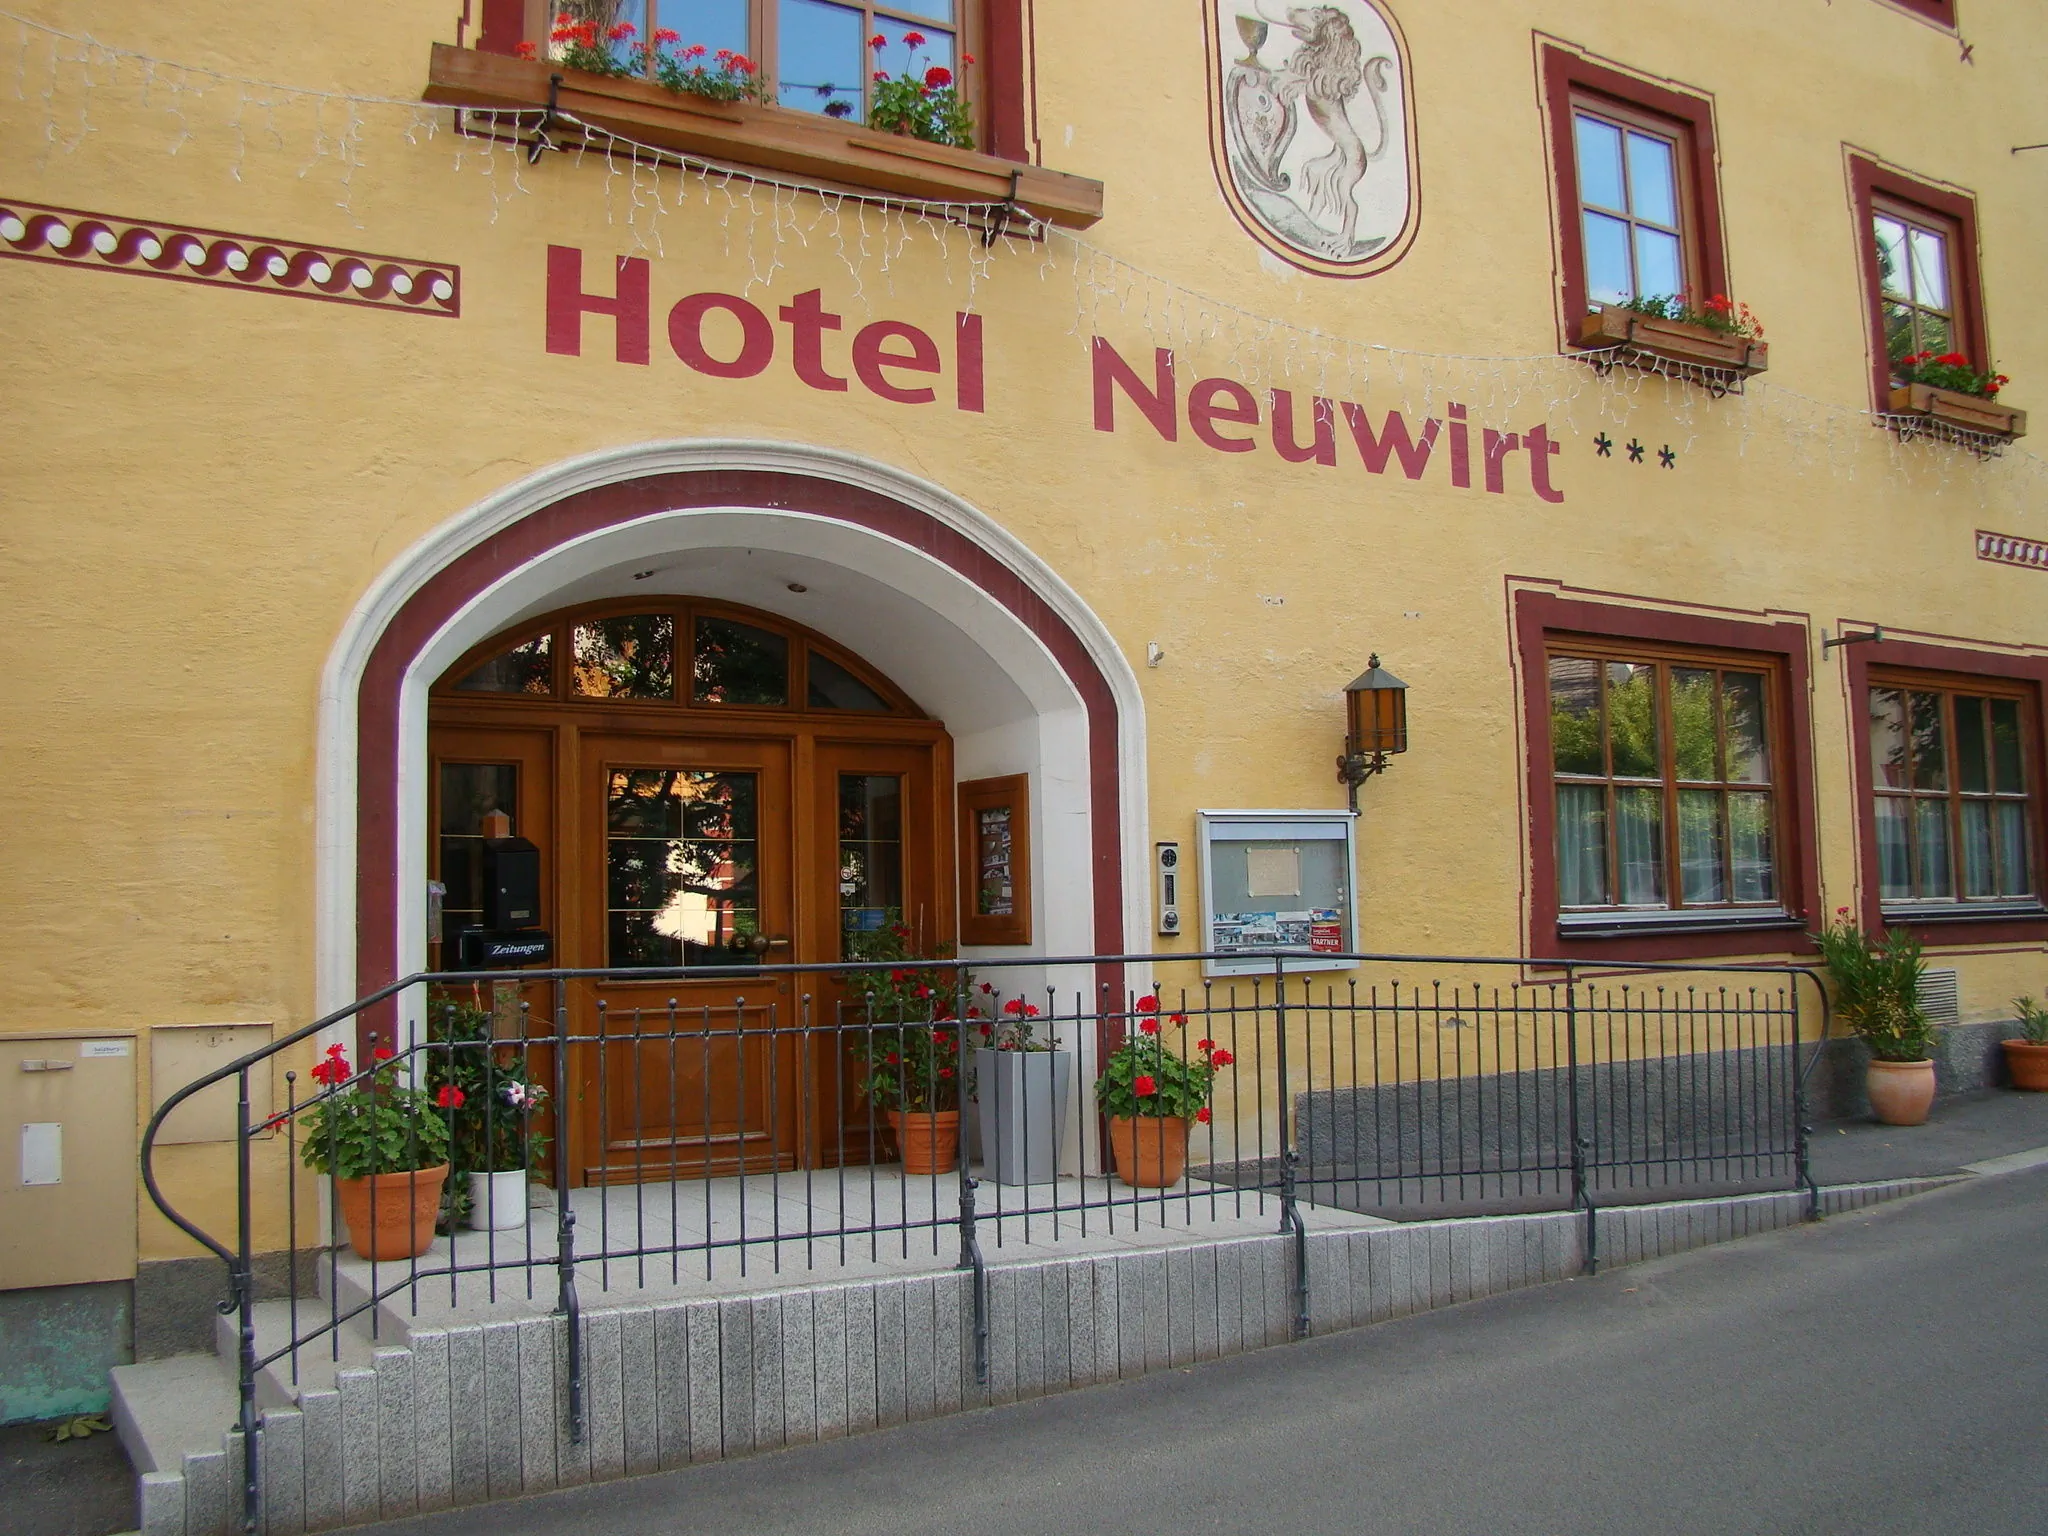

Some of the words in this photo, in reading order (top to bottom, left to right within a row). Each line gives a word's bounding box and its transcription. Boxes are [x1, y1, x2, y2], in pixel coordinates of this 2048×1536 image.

[545, 244, 985, 414] Hotel
[1091, 335, 1565, 504] Neuwirt
[1312, 938, 1339, 946] PARTNER
[491, 943, 545, 955] Zeitungen
